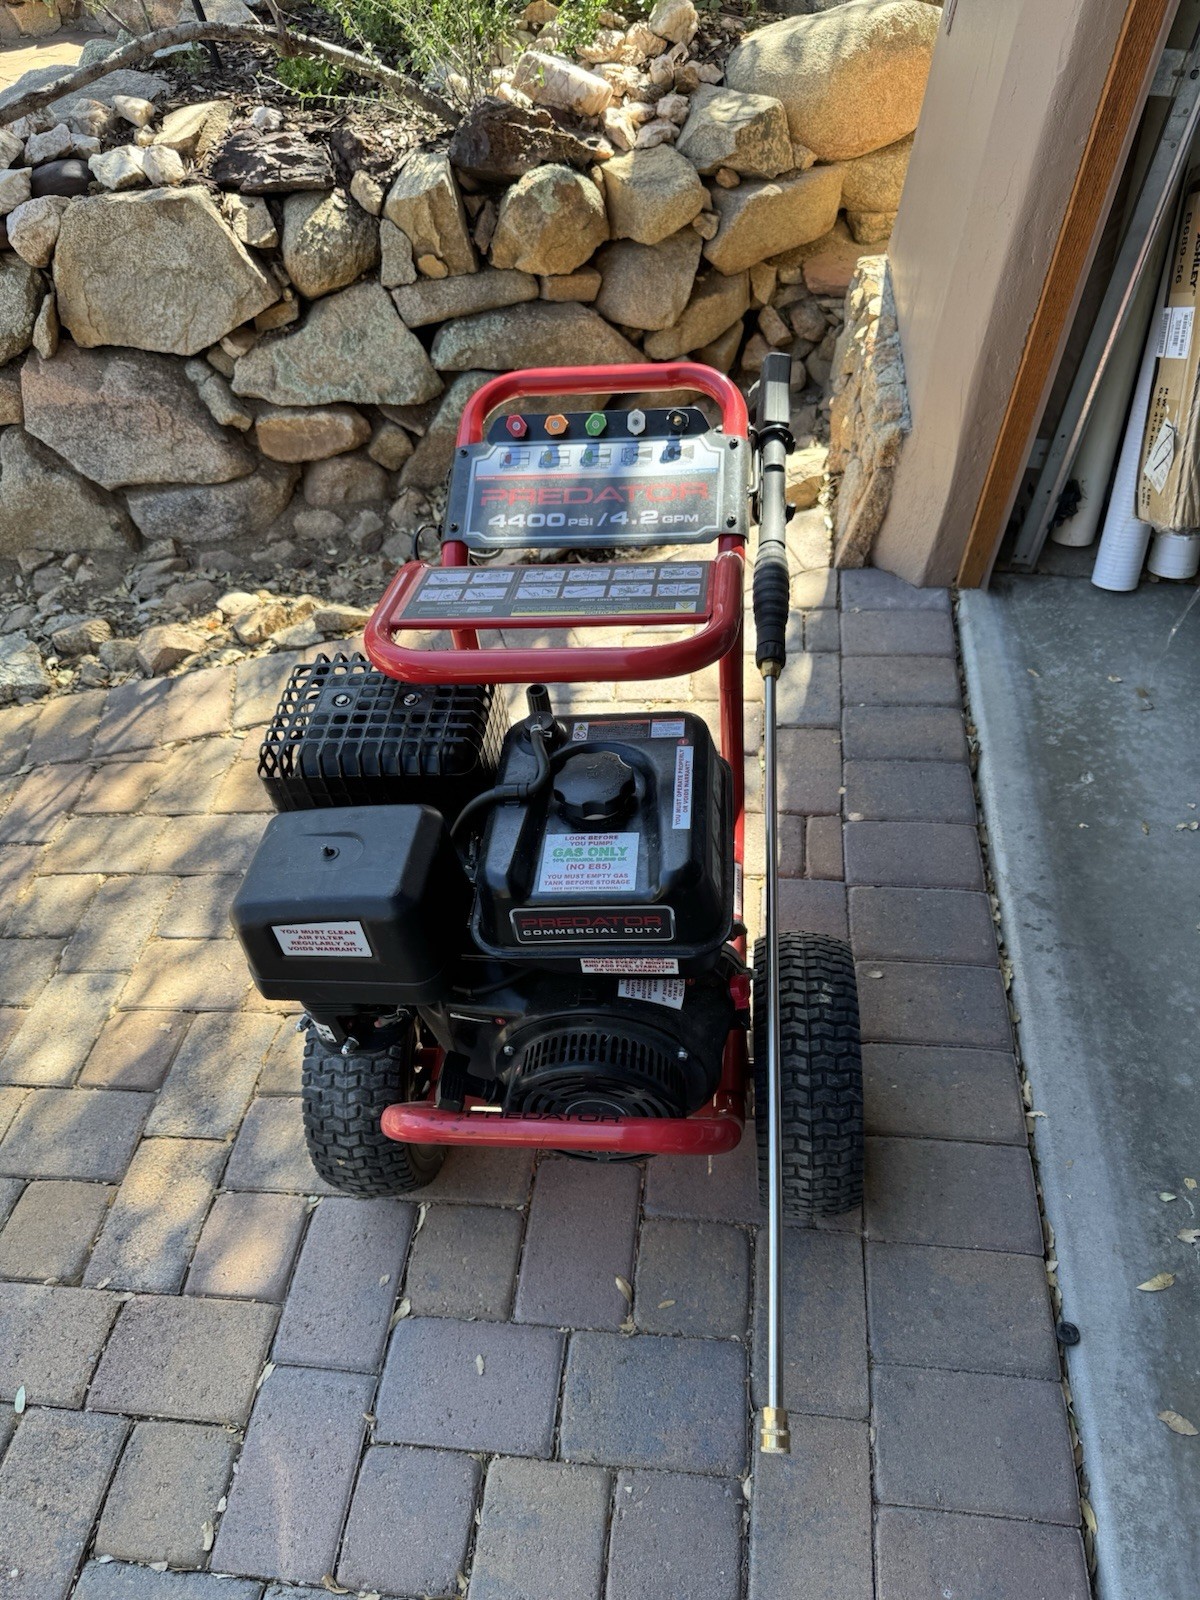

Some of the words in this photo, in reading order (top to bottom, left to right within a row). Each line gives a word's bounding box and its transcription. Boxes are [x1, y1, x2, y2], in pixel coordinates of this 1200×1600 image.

[480, 482, 709, 507] PREDATOR
[488, 512, 565, 528] 4400
[568, 516, 593, 527] PSI
[662, 513, 699, 524] GPM
[553, 847, 583, 857] GAS
[587, 847, 628, 856] ONLY
[520, 915, 663, 928] PREDATOR
[522, 927, 618, 936] COMMERCIAL
